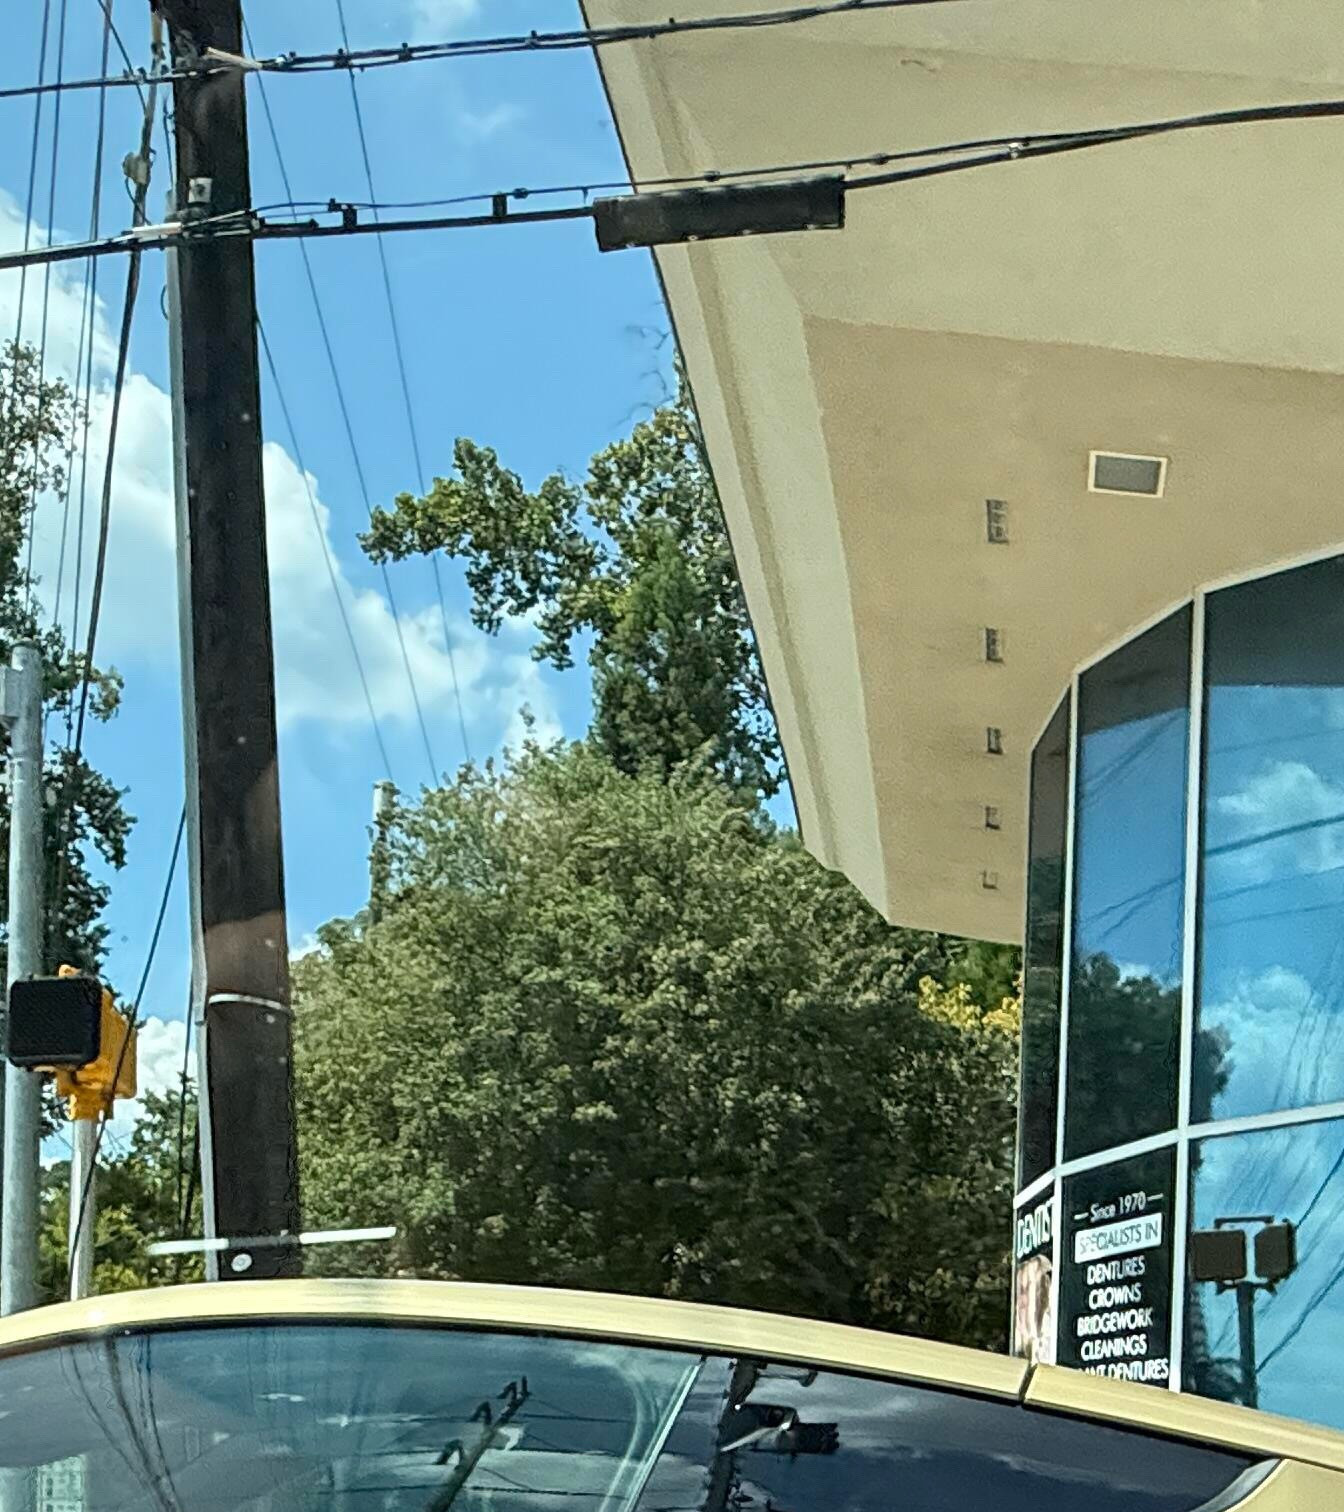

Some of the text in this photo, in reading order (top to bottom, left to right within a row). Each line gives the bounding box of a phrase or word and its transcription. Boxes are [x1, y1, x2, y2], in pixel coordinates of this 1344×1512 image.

[1090, 1190, 1147, 1222] Since 1970
[1145, 1220, 1159, 1240] IN
[1086, 1255, 1146, 1285] DENTURES
[1088, 1282, 1142, 1310] CROWNS
[1077, 1307, 1154, 1337] BRIDGEWORK
[1080, 1333, 1148, 1361] CLEANINGS
[1108, 1357, 1169, 1382] DENTURES
